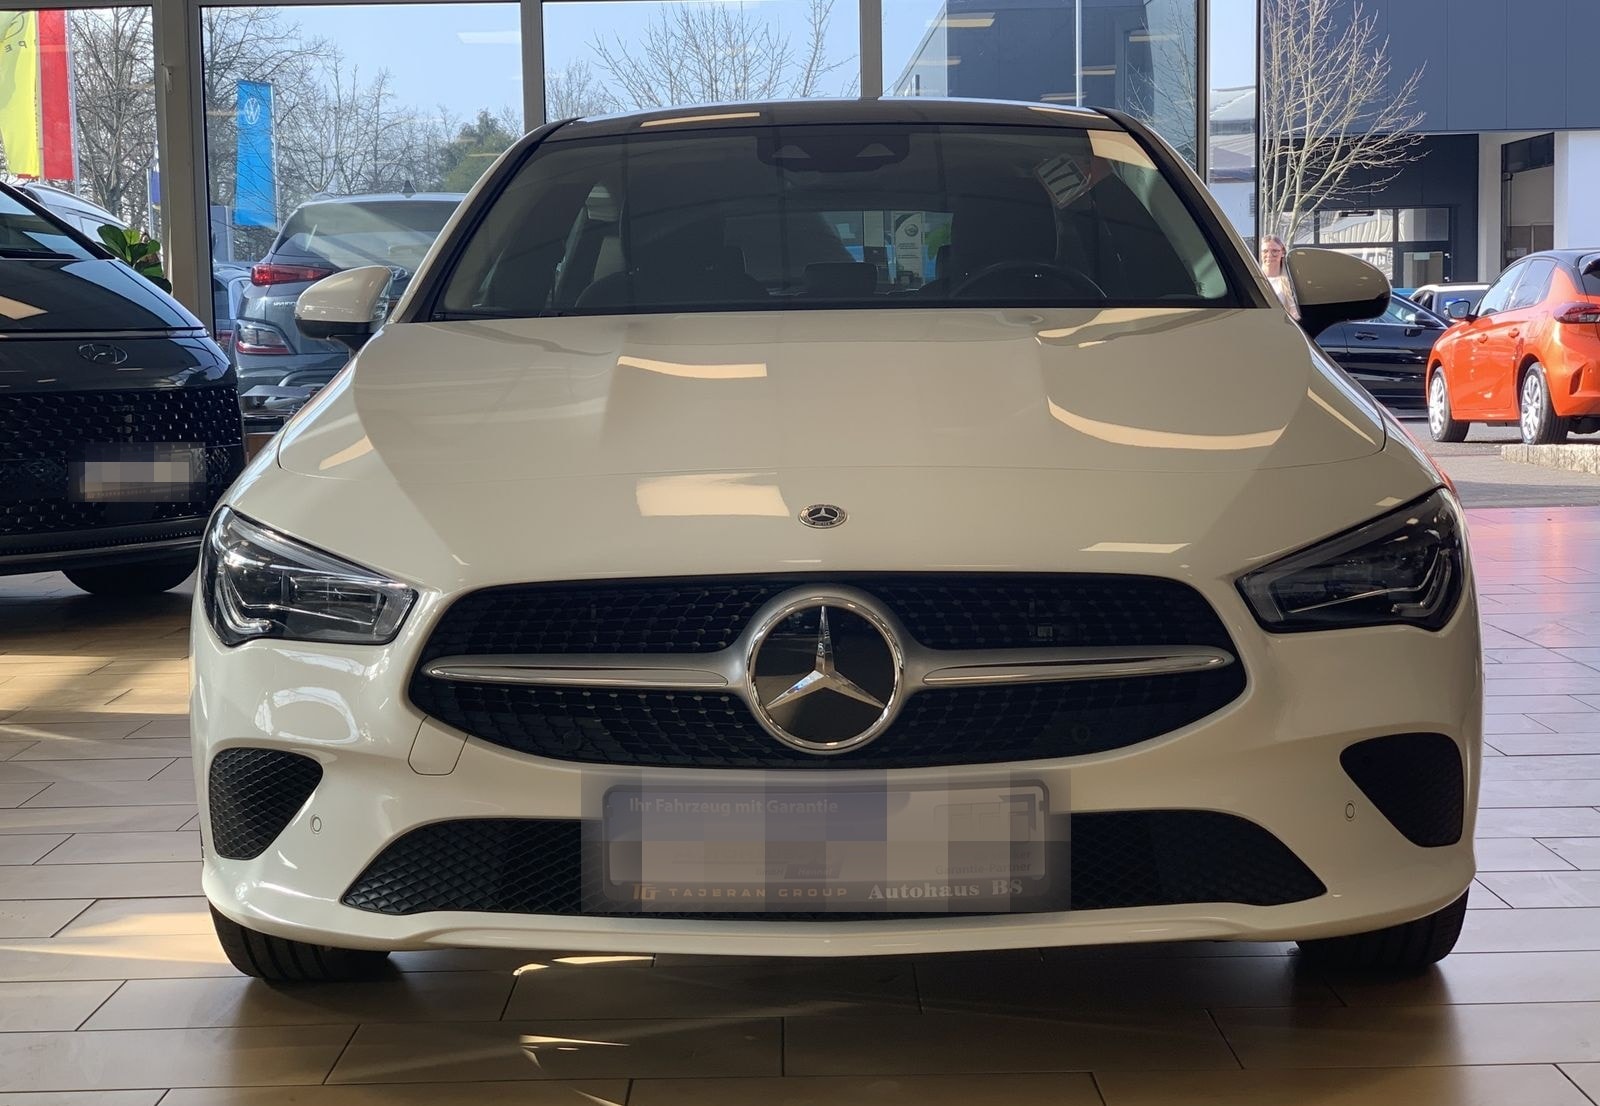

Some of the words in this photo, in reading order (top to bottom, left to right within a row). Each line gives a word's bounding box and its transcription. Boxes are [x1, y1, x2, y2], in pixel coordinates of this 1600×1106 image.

[629, 797, 653, 813] Ihr
[655, 798, 731, 816] Fahrzeug
[735, 798, 764, 814] mit
[766, 798, 839, 814] Garantie
[668, 887, 766, 897] TAJERAN
[777, 887, 848, 897] GROUP
[867, 881, 981, 901] Autohaus
